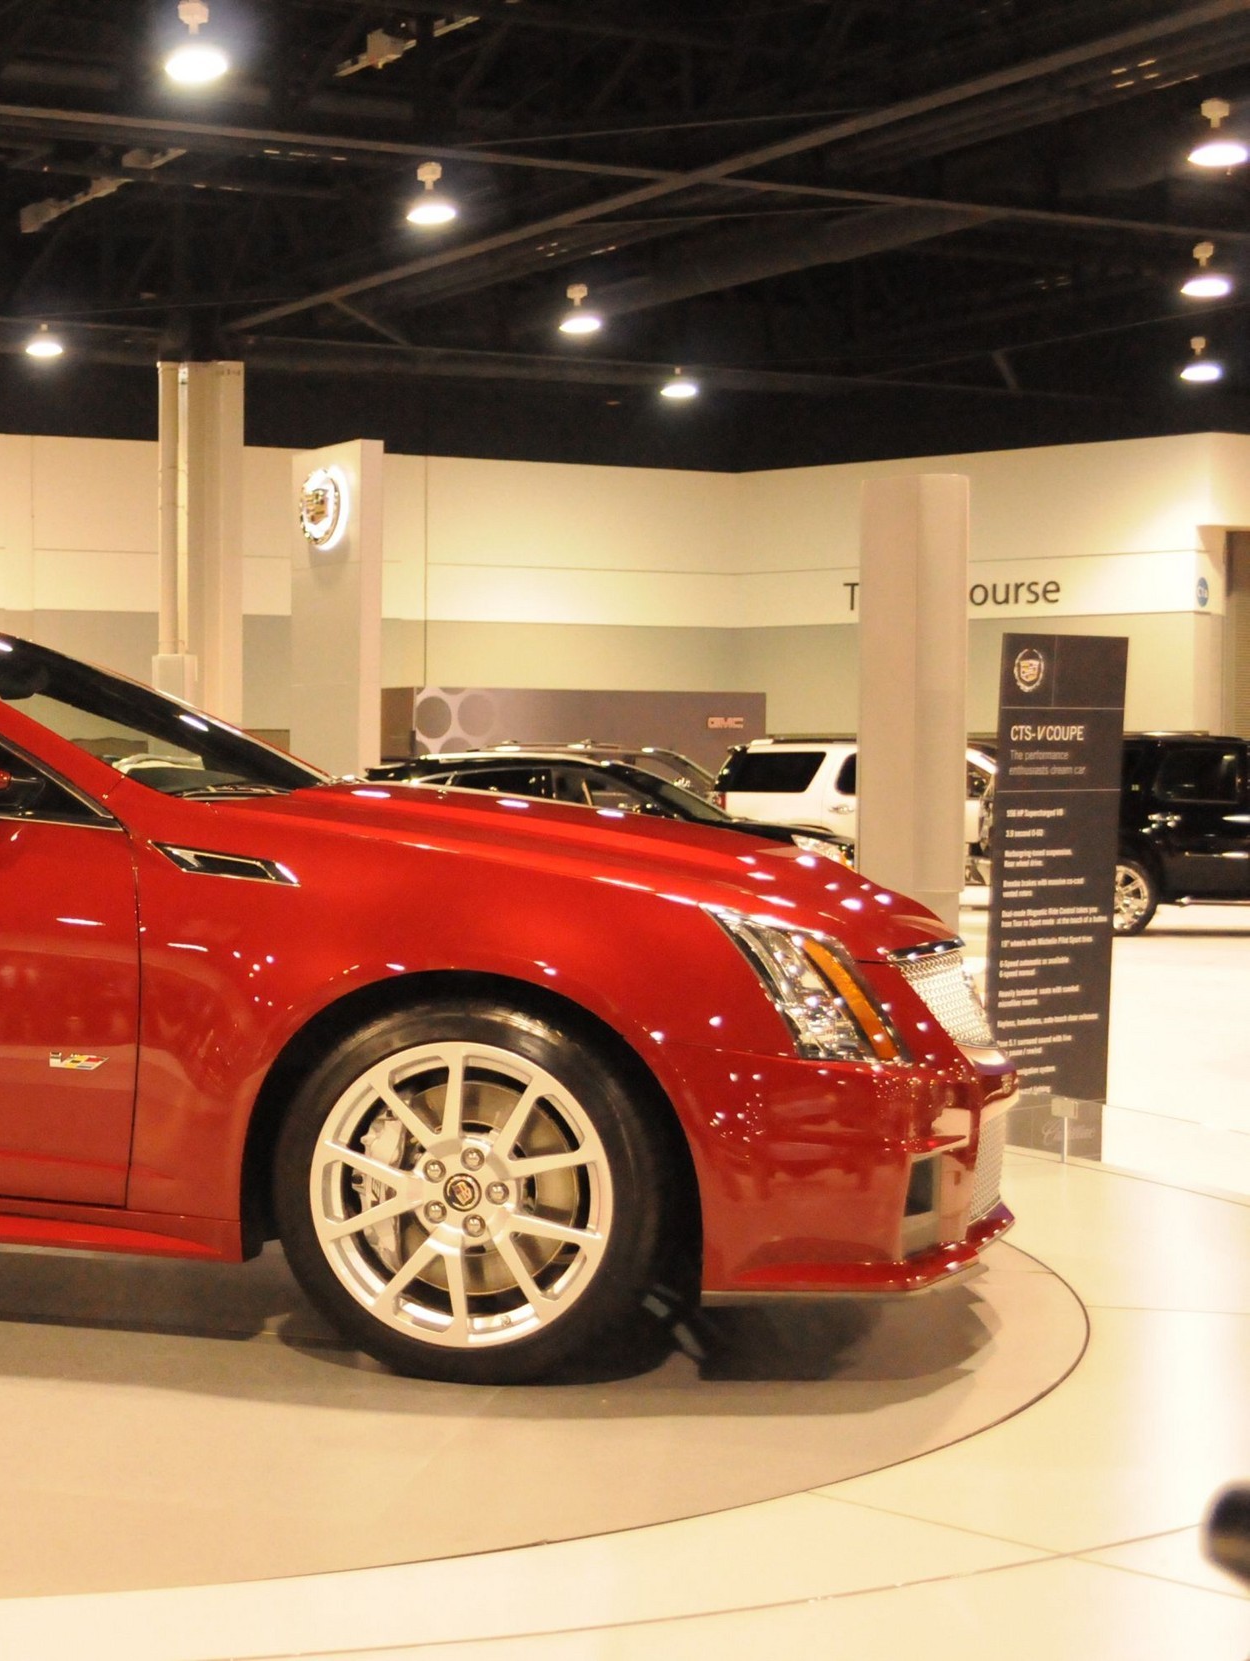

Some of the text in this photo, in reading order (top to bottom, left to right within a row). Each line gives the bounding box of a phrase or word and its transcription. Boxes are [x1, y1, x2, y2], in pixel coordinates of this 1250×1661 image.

[843, 579, 1061, 611] T ourse
[707, 716, 744, 729] GMC
[1010, 750, 1069, 761] The performance
